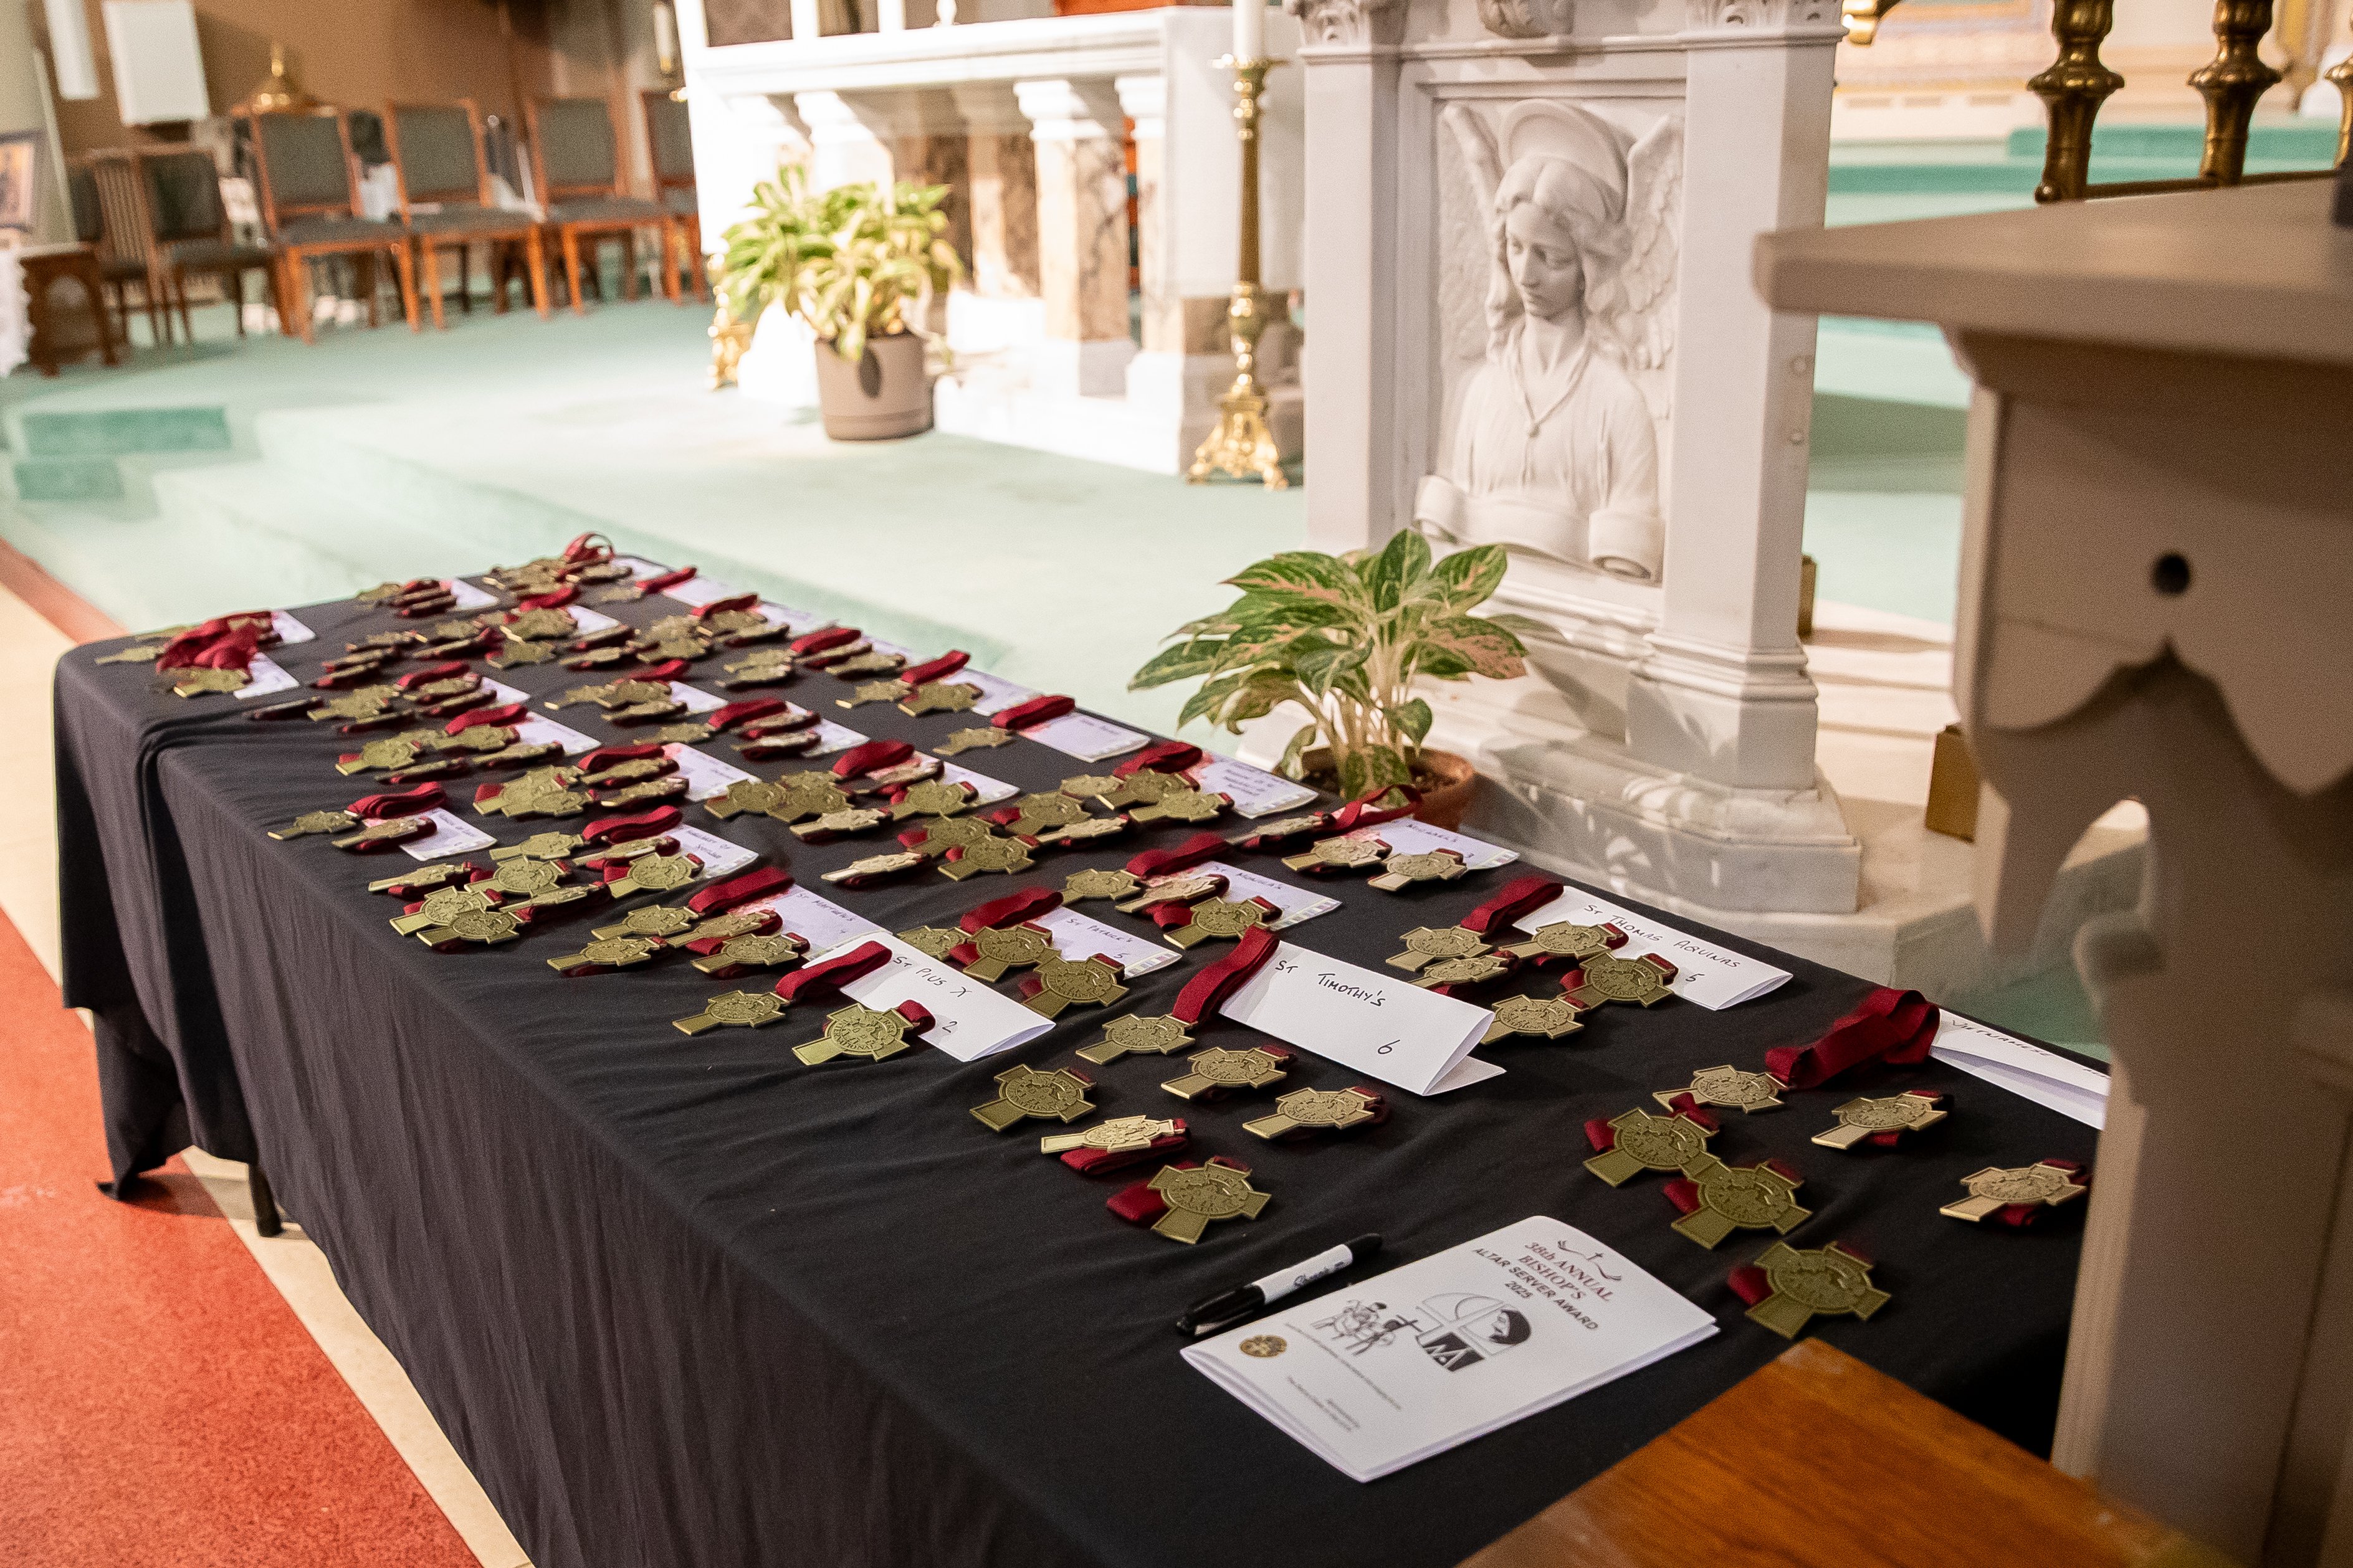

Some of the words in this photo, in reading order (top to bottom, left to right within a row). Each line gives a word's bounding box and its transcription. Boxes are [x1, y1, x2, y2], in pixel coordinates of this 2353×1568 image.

[1609, 915, 1663, 941] THOMAS
[1673, 940, 1741, 968] AQUINAS
[915, 967, 947, 986] PIUS
[950, 986, 973, 997] X
[1318, 973, 1386, 1007] TIMOTHY'S
[1685, 973, 1705, 982] 5
[942, 1020, 958, 1033] 2
[1377, 1039, 1401, 1055] 6
[1518, 1255, 1587, 1300] BISHOP'S
[1525, 1242, 1557, 1261] 38th
[1554, 1260, 1613, 1301] ANNUAL
[1472, 1248, 1511, 1268] ALTAR
[1509, 1266, 1557, 1298] SERVER
[1553, 1298, 1599, 1330] AWARD
